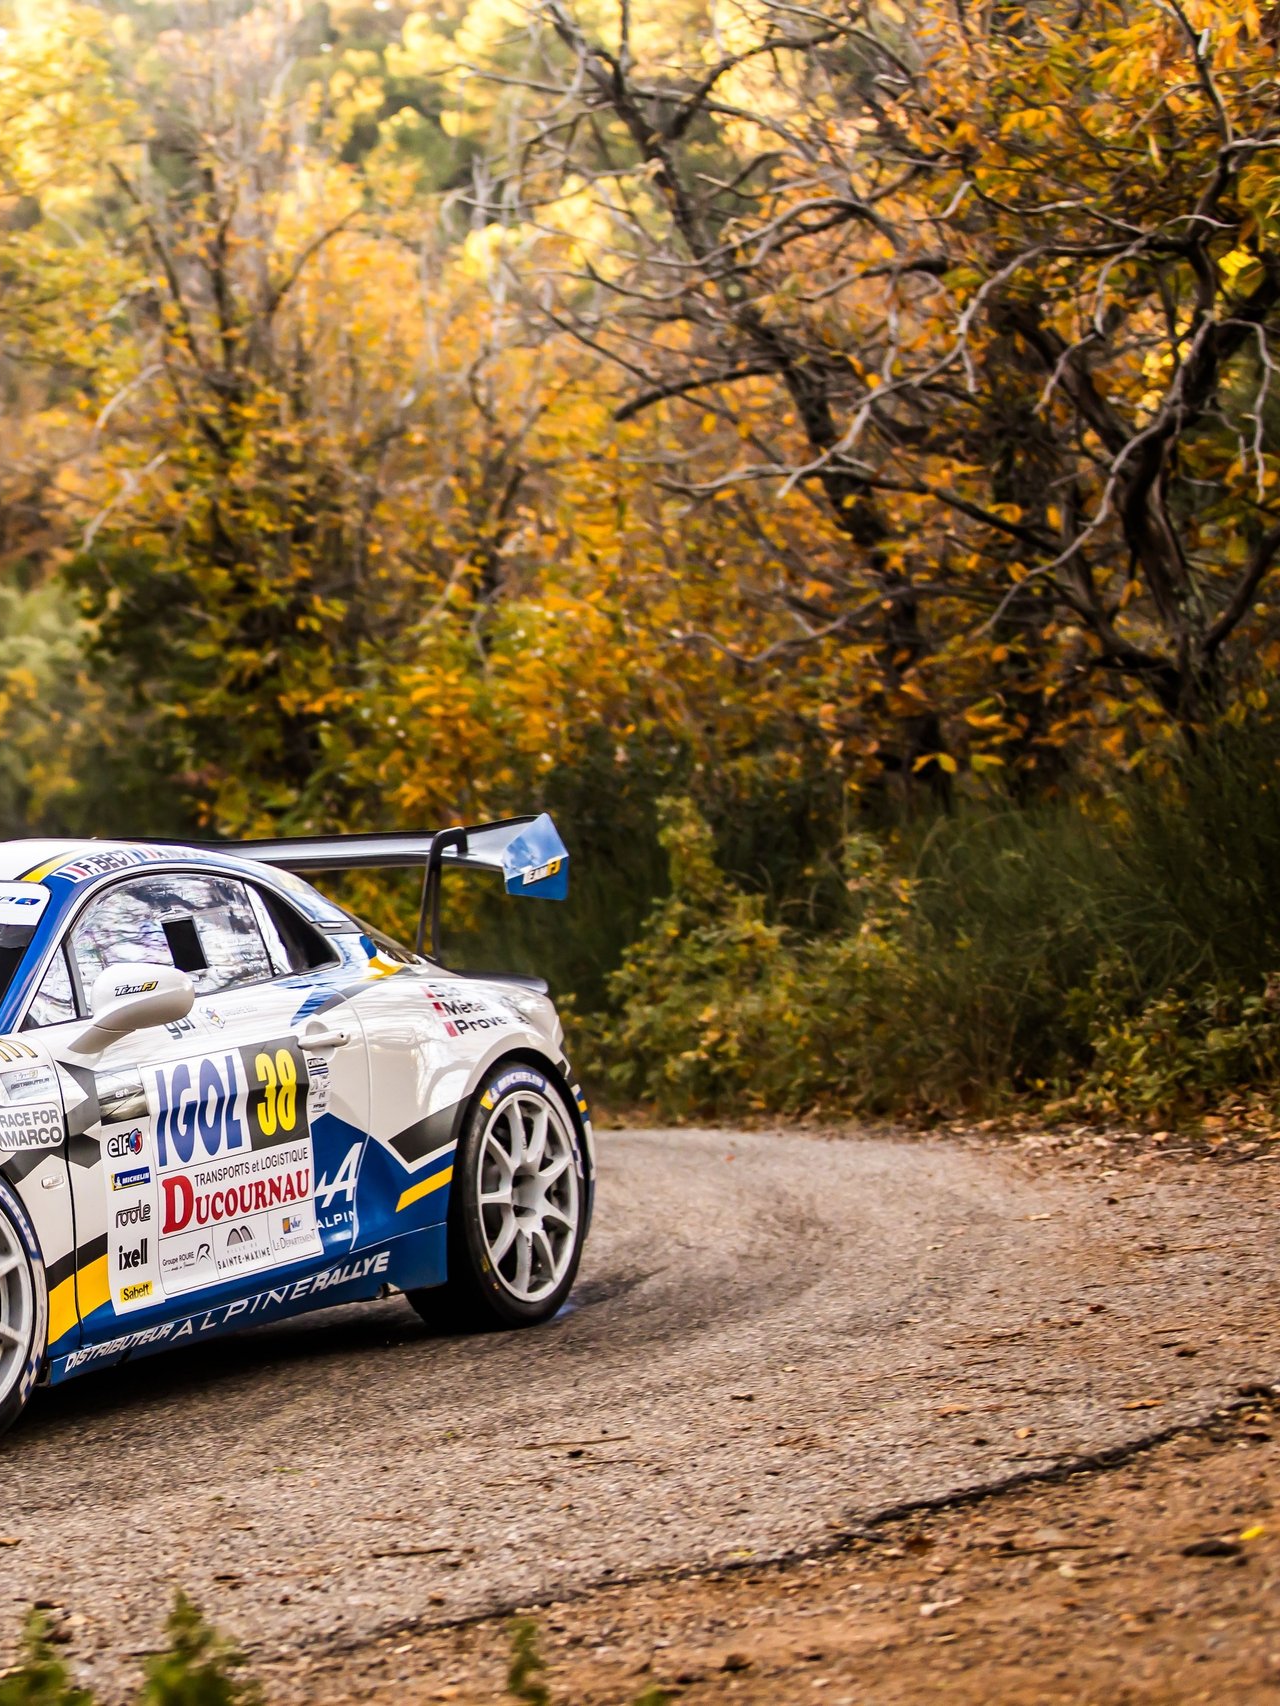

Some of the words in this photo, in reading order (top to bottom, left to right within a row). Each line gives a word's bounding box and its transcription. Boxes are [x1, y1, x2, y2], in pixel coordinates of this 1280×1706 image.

[114, 981, 159, 996] TEAMFJ
[32, 1108, 60, 1125] FOR
[154, 1054, 243, 1168] IGOL
[254, 1048, 298, 1136] 38
[6, 1126, 63, 1147] MARCO
[106, 1135, 130, 1158] elf
[194, 1163, 250, 1187] TRANSPORTS
[251, 1158, 260, 1173] et
[261, 1147, 309, 1170] LOGISTIQUE
[122, 1172, 150, 1186] MICHELIN
[161, 1168, 310, 1235] DUCOURNAU
[118, 1238, 148, 1271] ixell
[162, 1256, 179, 1267] Groupe
[178, 1252, 195, 1264] ROURE
[217, 1248, 272, 1270] SAINTE-MAXIME
[123, 1284, 150, 1302] Sabelt
[64, 1323, 176, 1373] DISTRIBUTEUR
[169, 1280, 314, 1342] ALPINE
[309, 1250, 390, 1294] RALLYE
